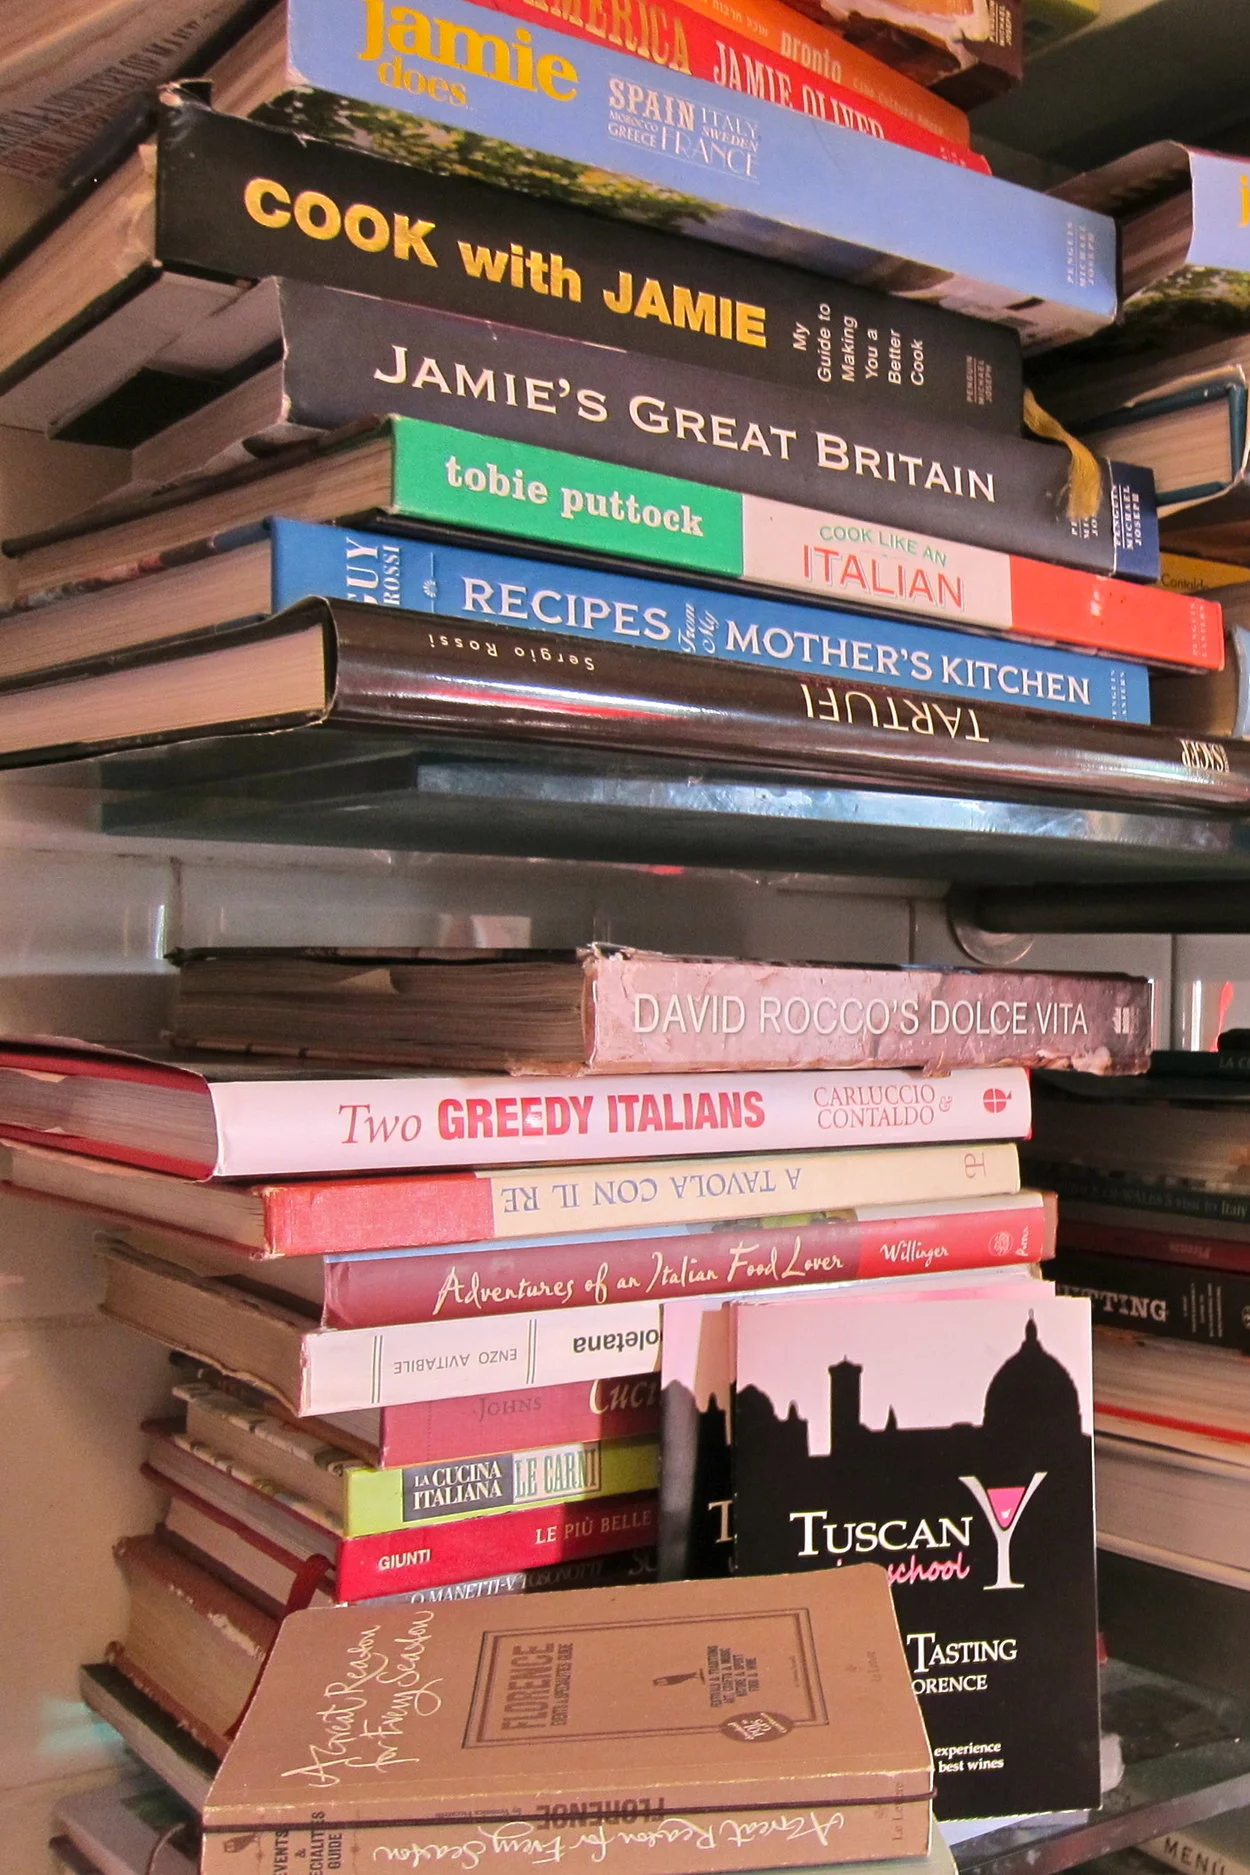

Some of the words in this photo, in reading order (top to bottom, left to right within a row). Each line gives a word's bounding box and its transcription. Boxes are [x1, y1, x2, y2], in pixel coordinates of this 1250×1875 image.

[358, 0, 580, 101] Jamie
[523, 0, 692, 76] ERICA
[713, 40, 792, 109] JAMIE
[780, 30, 843, 84] pronto
[608, 77, 696, 131] SPAIN
[607, 122, 657, 148] GREECE
[701, 107, 759, 139] ITALY
[702, 126, 759, 152] SWEDEN
[661, 126, 760, 181] FRANCE
[244, 177, 440, 267] COOK
[456, 243, 582, 303] with
[602, 270, 768, 349] JAMIE
[817, 302, 832, 322] to
[793, 321, 811, 351] My
[841, 315, 859, 383] Making
[867, 328, 878, 341] a
[817, 326, 832, 383] Guide
[865, 345, 879, 380] You
[888, 328, 902, 385] Better
[910, 338, 924, 386] Cook
[373, 344, 610, 422] JAMIE'S
[627, 394, 797, 460] GREAT
[816, 431, 995, 503] BRITAIN
[445, 455, 548, 505] tobie
[561, 485, 703, 538] puttock
[1124, 484, 1133, 550] MICHAEL
[1132, 492, 1142, 546] JOSEPH
[818, 525, 873, 545] COOK
[877, 535, 918, 554] LIKE
[923, 546, 947, 567] AN
[383, 545, 400, 605] ROSSI
[802, 545, 963, 609] ITALIAN
[427, 633, 498, 657] Rossi
[462, 577, 670, 641] RECIPES
[724, 619, 932, 681] MOTHER'S
[941, 657, 1090, 705] KITCHEN
[515, 646, 595, 671] Sergio
[801, 683, 989, 744] TARTUFI
[633, 992, 746, 1035] DAVID
[758, 994, 919, 1035] ROCCO'S
[929, 999, 1027, 1035] DOLCE
[1035, 1001, 1088, 1035] VITA
[1219, 1056, 1236, 1070] LA
[813, 1084, 936, 1107] CARLUCCIO
[338, 1104, 421, 1144] Two
[437, 1095, 594, 1140] GREEDY
[607, 1090, 765, 1133] ITALIANS
[817, 1106, 935, 1129] CONTALDO
[593, 1173, 658, 1202] CON
[670, 1169, 776, 1198] TAVOLA
[787, 1167, 802, 1189] A
[501, 1187, 540, 1212] RE
[556, 1184, 580, 1207] IL
[1222, 1201, 1249, 1219] Italy
[434, 1266, 573, 1315] Adventures
[585, 1262, 608, 1302] of
[617, 1275, 640, 1289] an
[649, 1252, 717, 1291] Italian
[729, 1240, 777, 1282] Food
[781, 1236, 843, 1274] Lover
[880, 1243, 949, 1265] Willinger
[479, 1348, 517, 1365] ENZO
[573, 1329, 659, 1353] oletana
[393, 1354, 470, 1374] AVITABILE
[415, 1475, 431, 1487] LA
[432, 1460, 503, 1485] CUCINA
[515, 1459, 538, 1498] LE
[544, 1448, 600, 1493] CARNI
[413, 1482, 503, 1510] ITALIANA
[535, 1527, 557, 1545] LE
[564, 1517, 593, 1539] PIÙ
[600, 1510, 652, 1534] BELLE
[378, 1549, 431, 1571] GIUNTI
[886, 1552, 970, 1586] school
[325, 1624, 389, 1699] Reason
[376, 1609, 436, 1687] Season
[501, 1643, 554, 1730] FLORENCE
[911, 1674, 988, 1696] ORENCE
[359, 1678, 444, 1738] Every
[316, 1694, 369, 1758] Great
[281, 1744, 341, 1788] A
[345, 1740, 420, 1774] for
[934, 1741, 1002, 1759] experience
[938, 1758, 965, 1774] best
[967, 1756, 1005, 1773] wines
[537, 1797, 665, 1830] FLORENCE
[328, 1832, 343, 1869] GUIDE
[478, 1821, 564, 1866] Every
[569, 1821, 607, 1863] for
[623, 1817, 716, 1850] Reason
[718, 1819, 809, 1848] Great
[295, 1848, 306, 1858] &
[373, 1839, 487, 1870] Season
